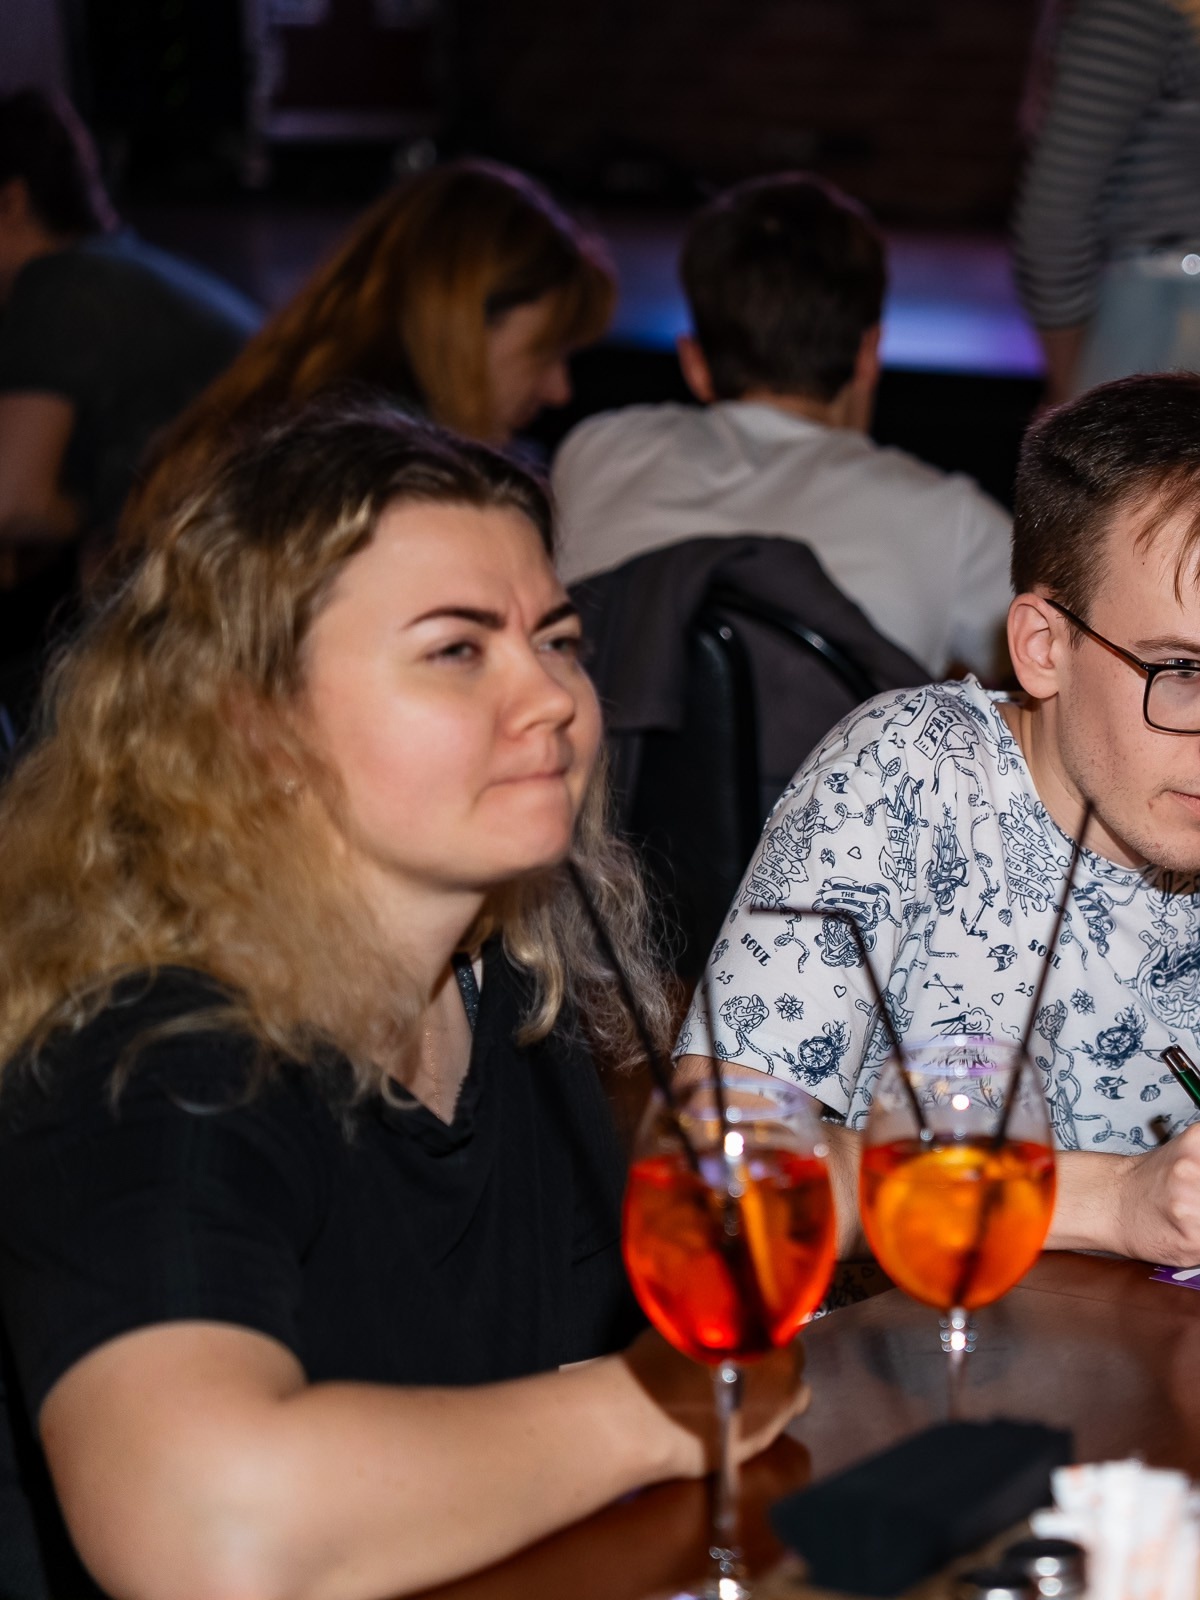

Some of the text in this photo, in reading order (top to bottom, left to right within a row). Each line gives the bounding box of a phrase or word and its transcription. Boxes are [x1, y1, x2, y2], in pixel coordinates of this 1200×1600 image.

[776, 831, 803, 858] SAILOR
[840, 891, 856, 899] THE
[740, 932, 772, 967] SOUL
[715, 970, 734, 985] 25
[1014, 981, 1035, 997] 25
